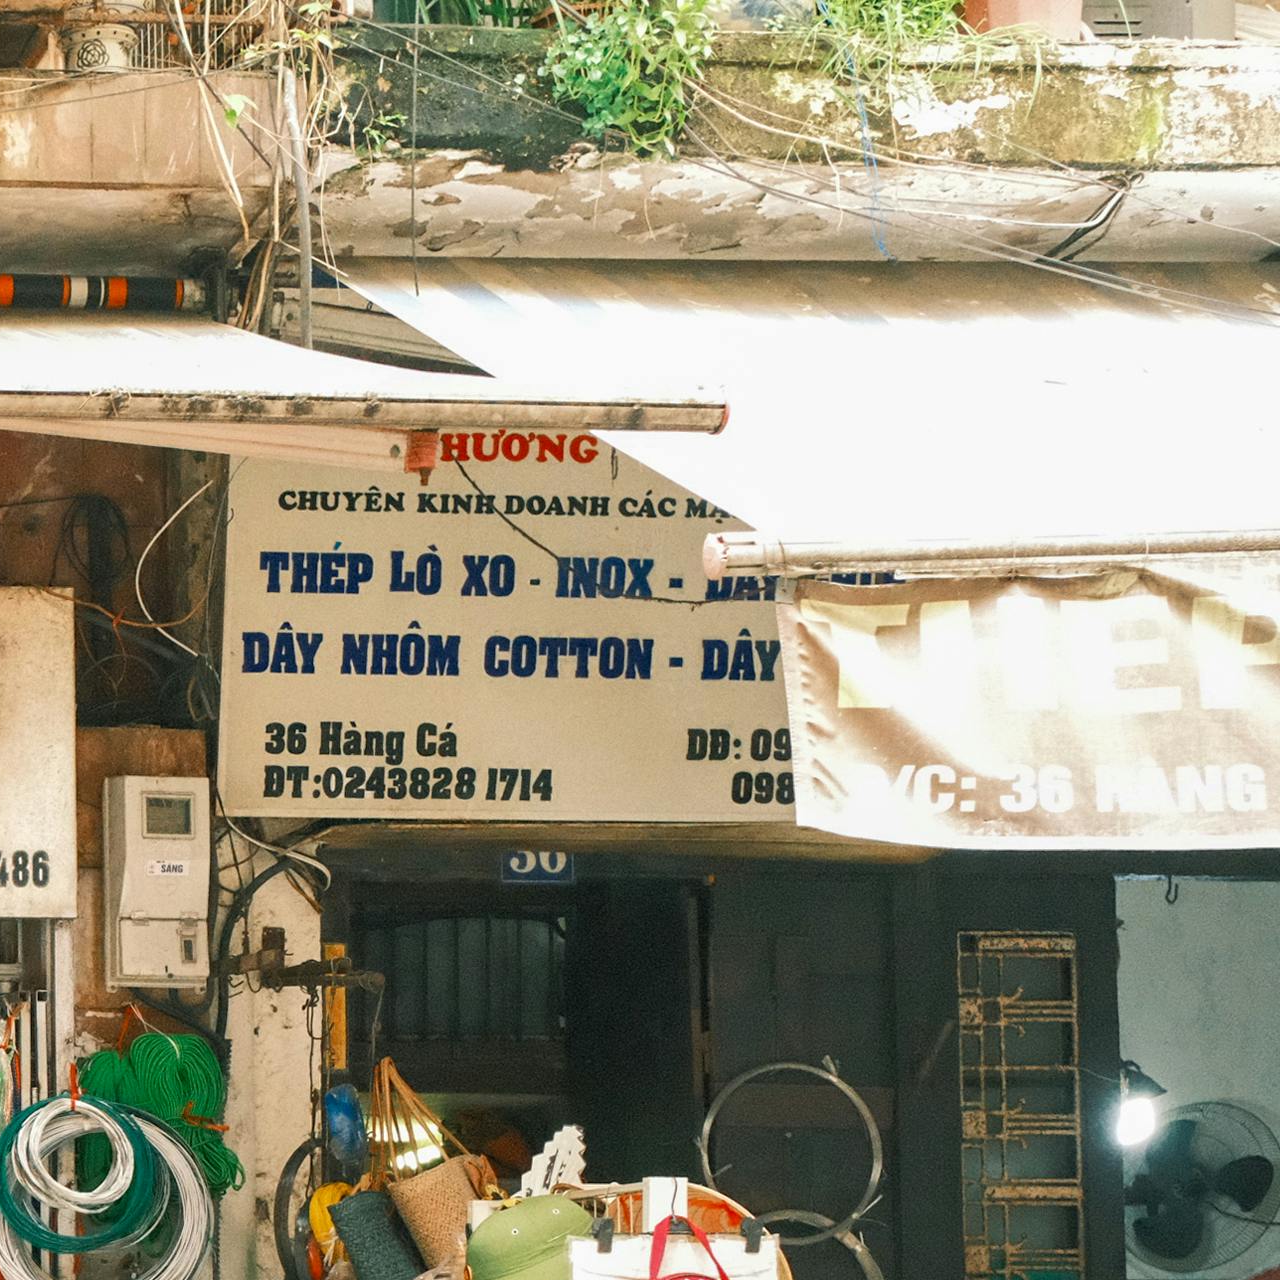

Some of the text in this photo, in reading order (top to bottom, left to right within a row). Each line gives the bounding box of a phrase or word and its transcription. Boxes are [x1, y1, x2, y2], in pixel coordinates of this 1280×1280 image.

[440, 429, 598, 463] HƯƠNG
[279, 486, 404, 512] CHUYÊN
[417, 493, 495, 514] KINH
[505, 495, 609, 517] DOANH
[619, 490, 676, 518] CÁC
[260, 542, 373, 594] THÉP
[390, 544, 442, 593] LÒ
[462, 555, 516, 597] XO
[556, 556, 655, 599] INOX
[242, 621, 324, 674] DÂY
[341, 620, 461, 676] NHÔM
[484, 636, 654, 680] COTTON
[265, 721, 458, 764] 36 Hàng Cá
[485, 768, 553, 802] 1714
[1000, 764, 1074, 815] 36
